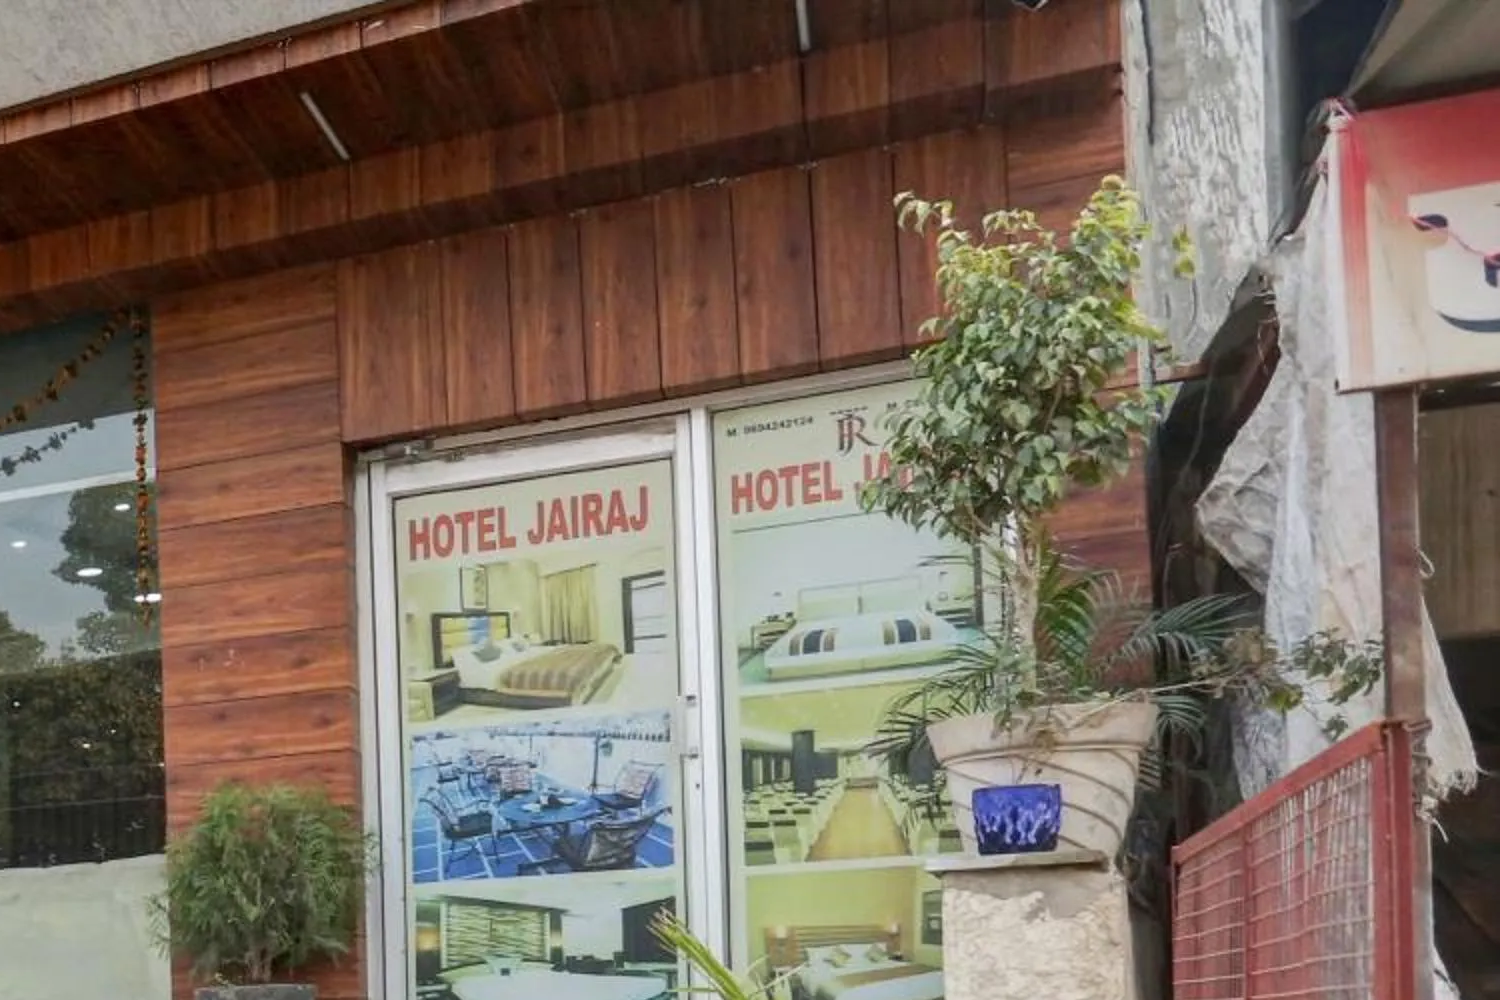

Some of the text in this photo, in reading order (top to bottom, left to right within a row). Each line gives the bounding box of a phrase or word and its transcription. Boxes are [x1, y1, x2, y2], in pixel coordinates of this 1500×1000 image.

[731, 460, 843, 515] HOTEL
[408, 485, 648, 561] HOTEL JAIRAJ
